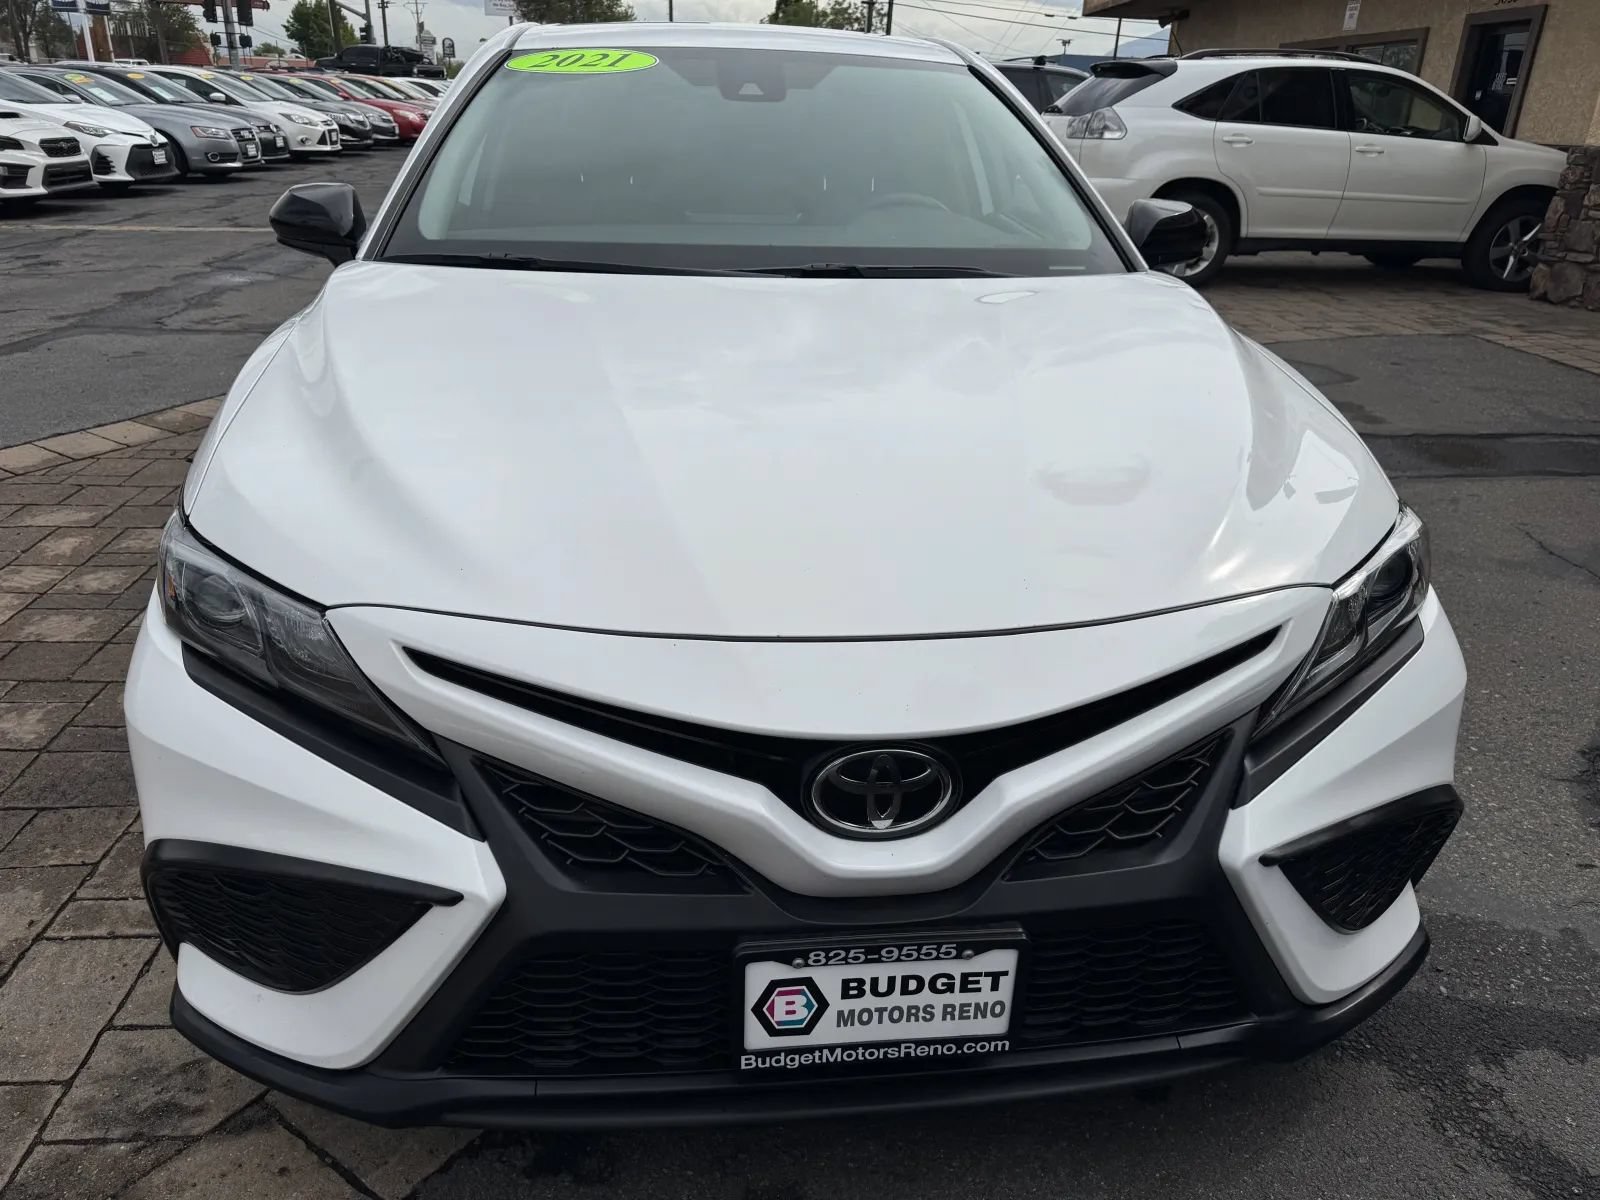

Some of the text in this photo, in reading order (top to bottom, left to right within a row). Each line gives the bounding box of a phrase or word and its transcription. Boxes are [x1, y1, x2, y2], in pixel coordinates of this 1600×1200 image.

[529, 53, 631, 68] 2021
[807, 944, 957, 966] 825-9555
[840, 970, 1009, 1000] BUDGET
[836, 1000, 1006, 1028] MOTORS RENO
[740, 1040, 1010, 1070] BudgetMotorsReno.com
